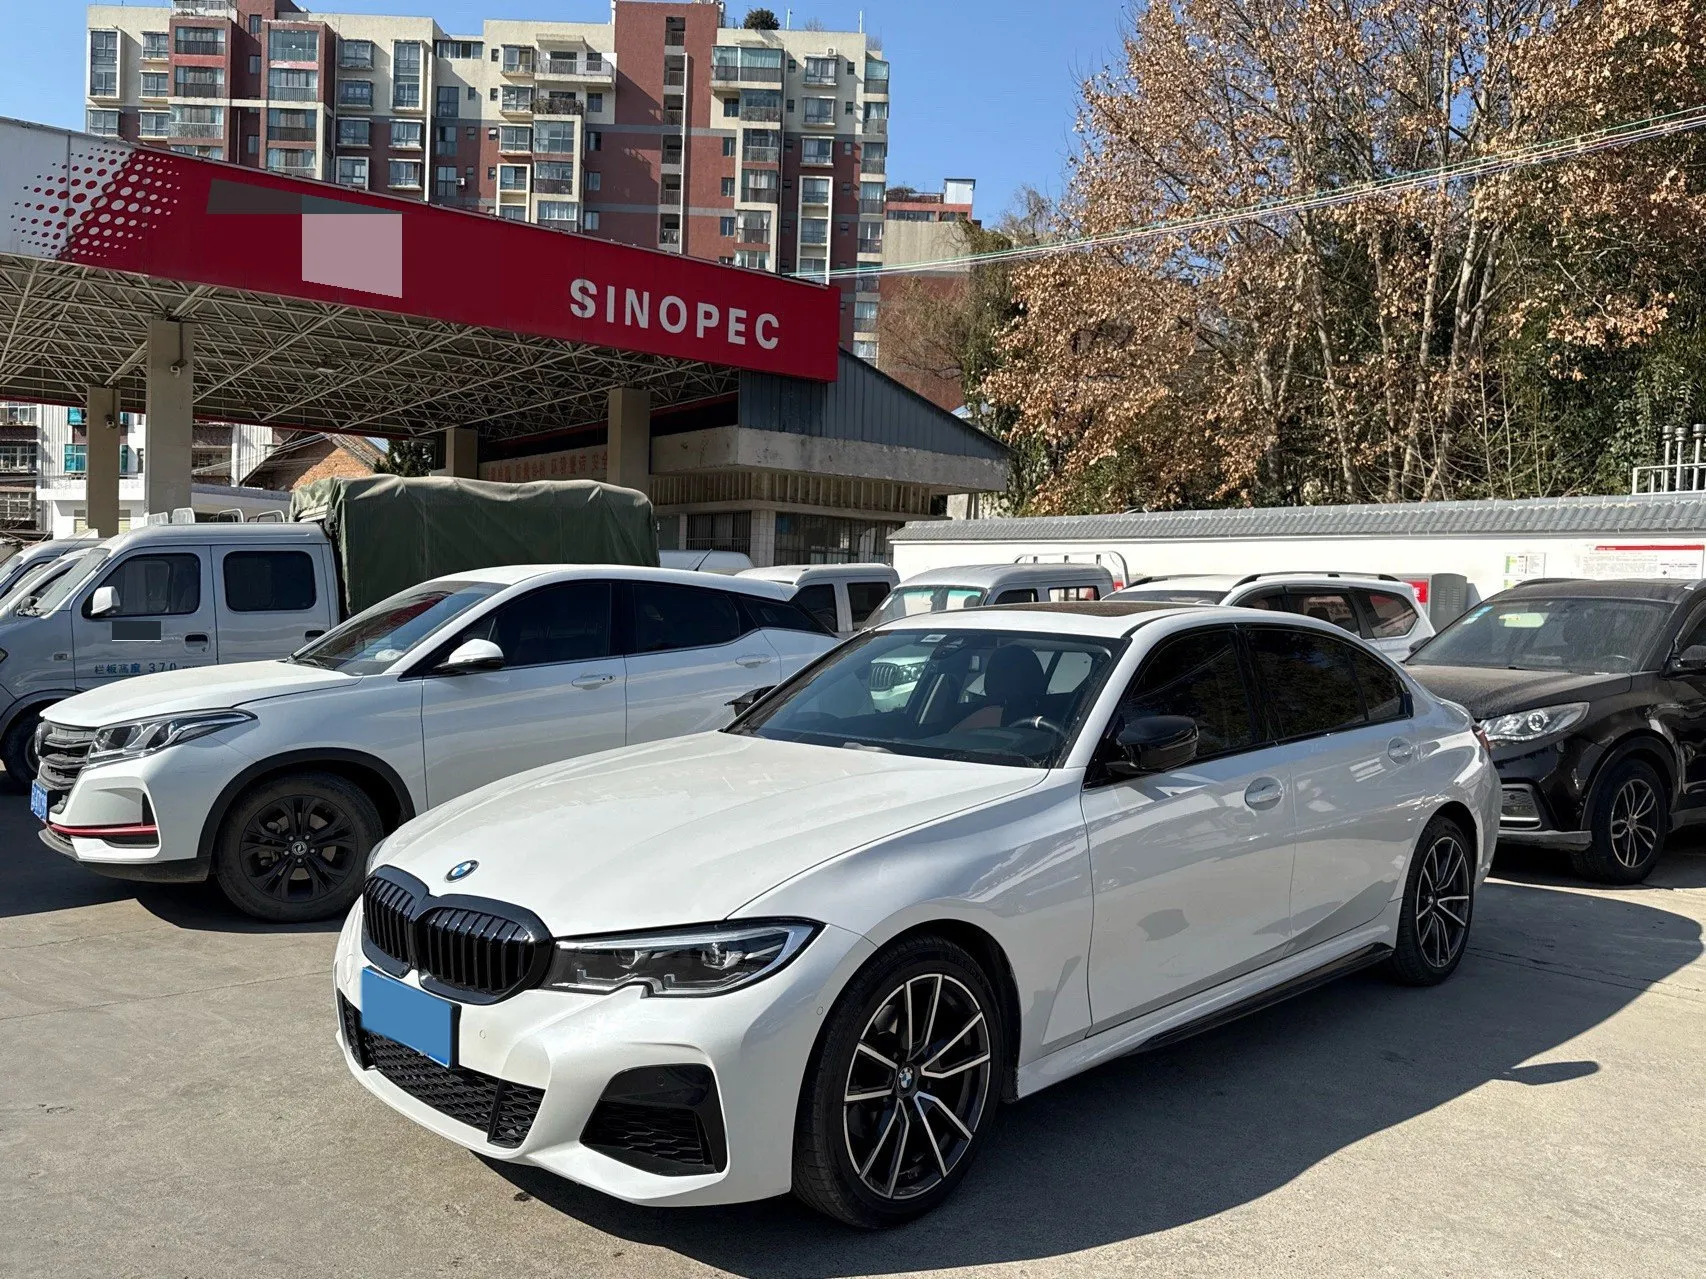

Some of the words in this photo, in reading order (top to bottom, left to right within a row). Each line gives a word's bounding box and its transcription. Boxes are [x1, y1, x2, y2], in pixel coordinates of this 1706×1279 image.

[570, 278, 780, 350] SINOPEC
[94, 663, 141, 675] 栏板高度
[148, 662, 177, 673] 370
